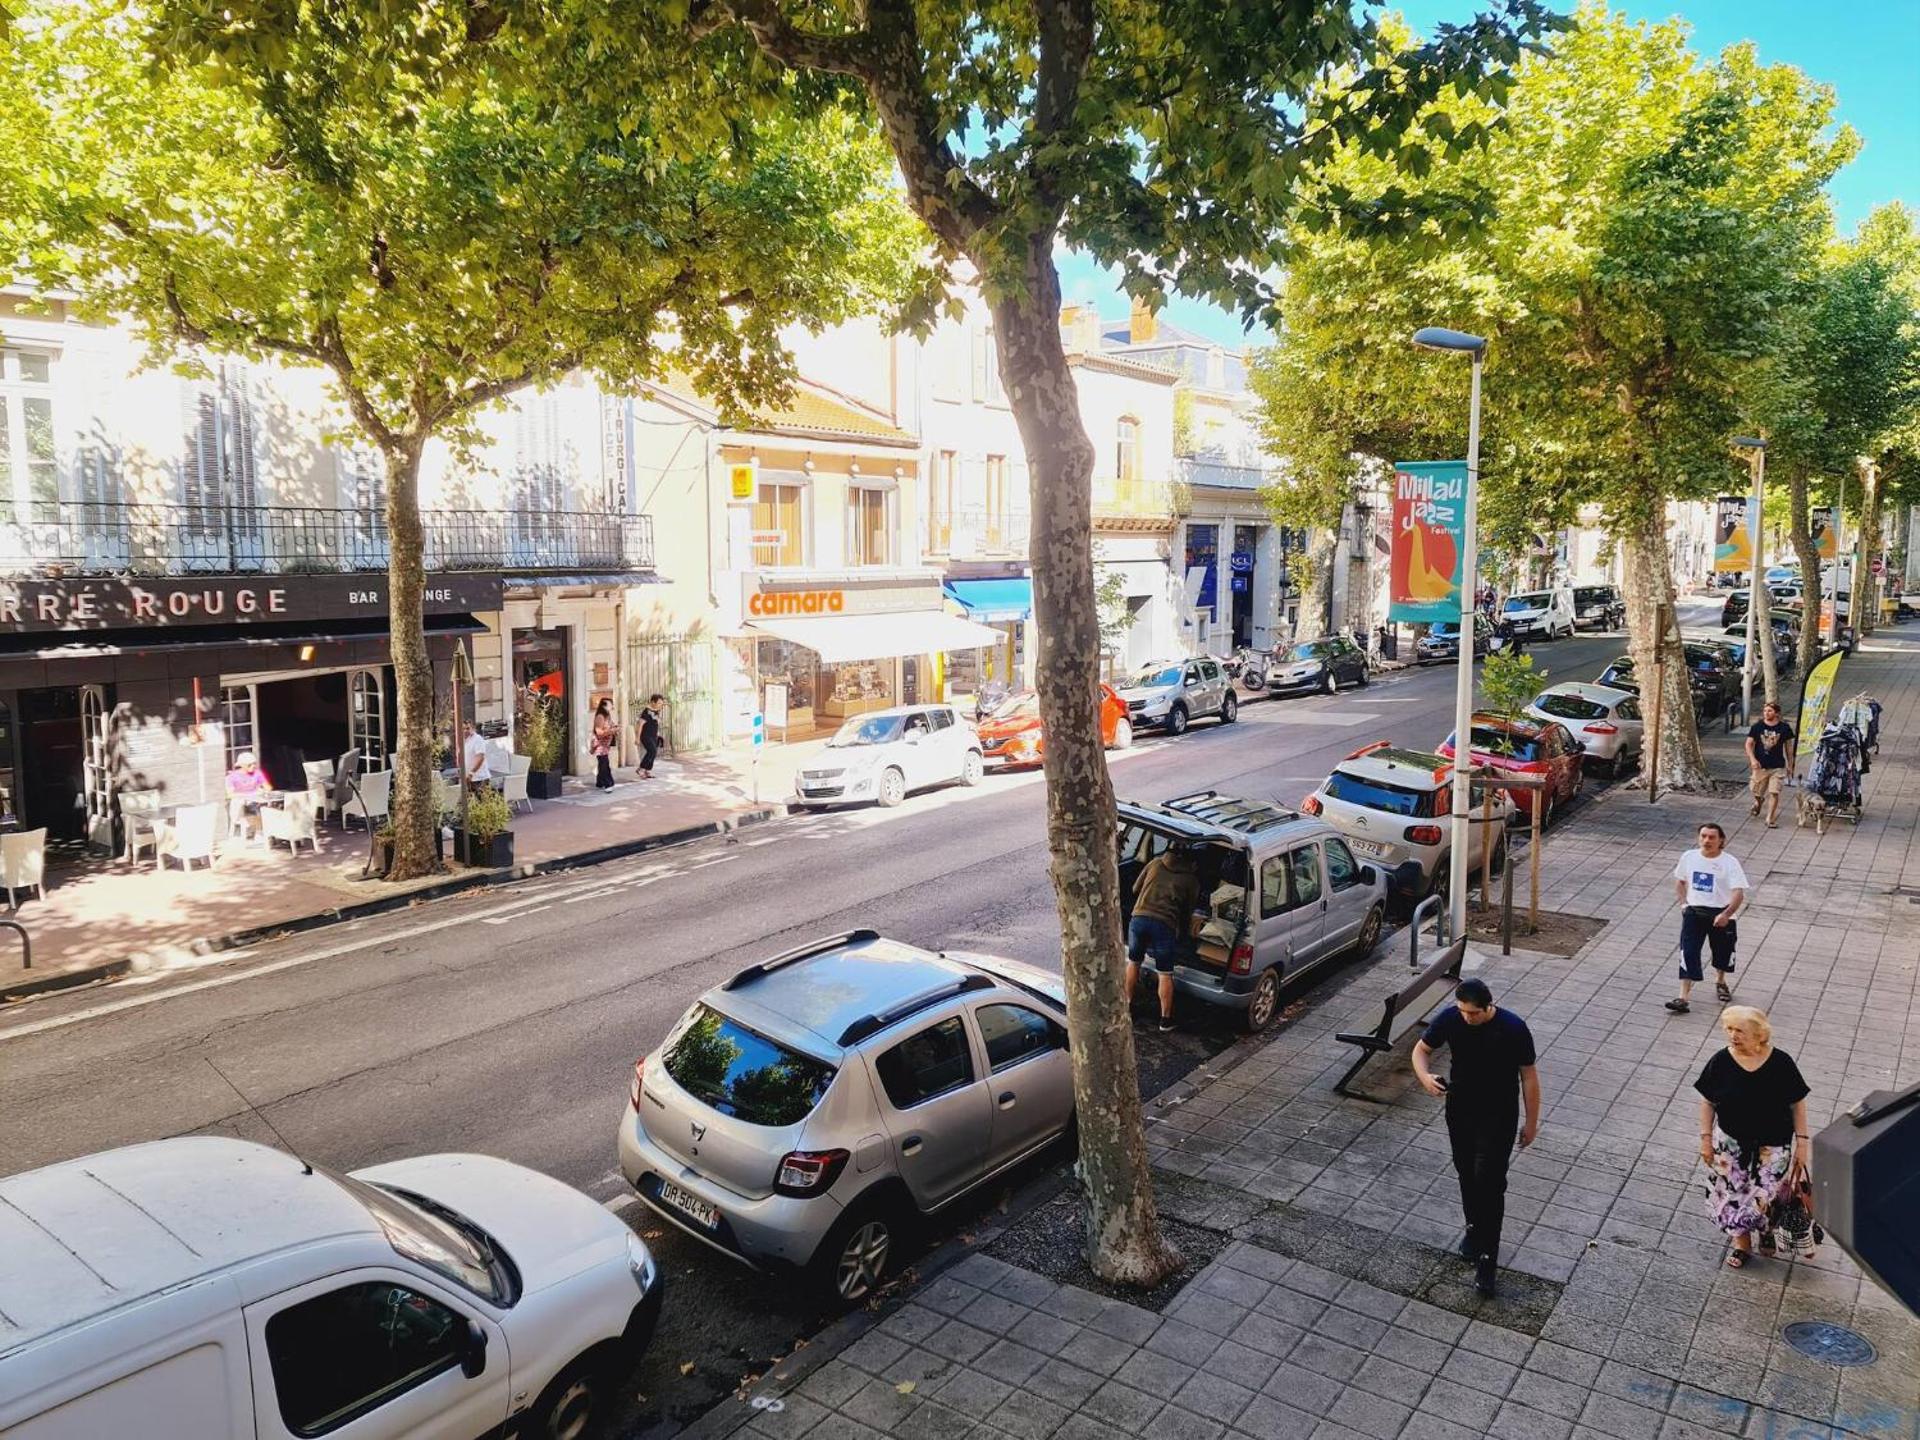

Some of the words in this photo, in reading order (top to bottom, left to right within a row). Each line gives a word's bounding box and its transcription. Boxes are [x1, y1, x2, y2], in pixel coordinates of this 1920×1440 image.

[1398, 475, 1462, 500] Millau
[1431, 526, 1461, 535] Festival
[136, 589, 287, 618] ROUGE
[349, 591, 378, 604] BAR
[422, 589, 452, 601] NGE
[750, 590, 843, 616] camara
